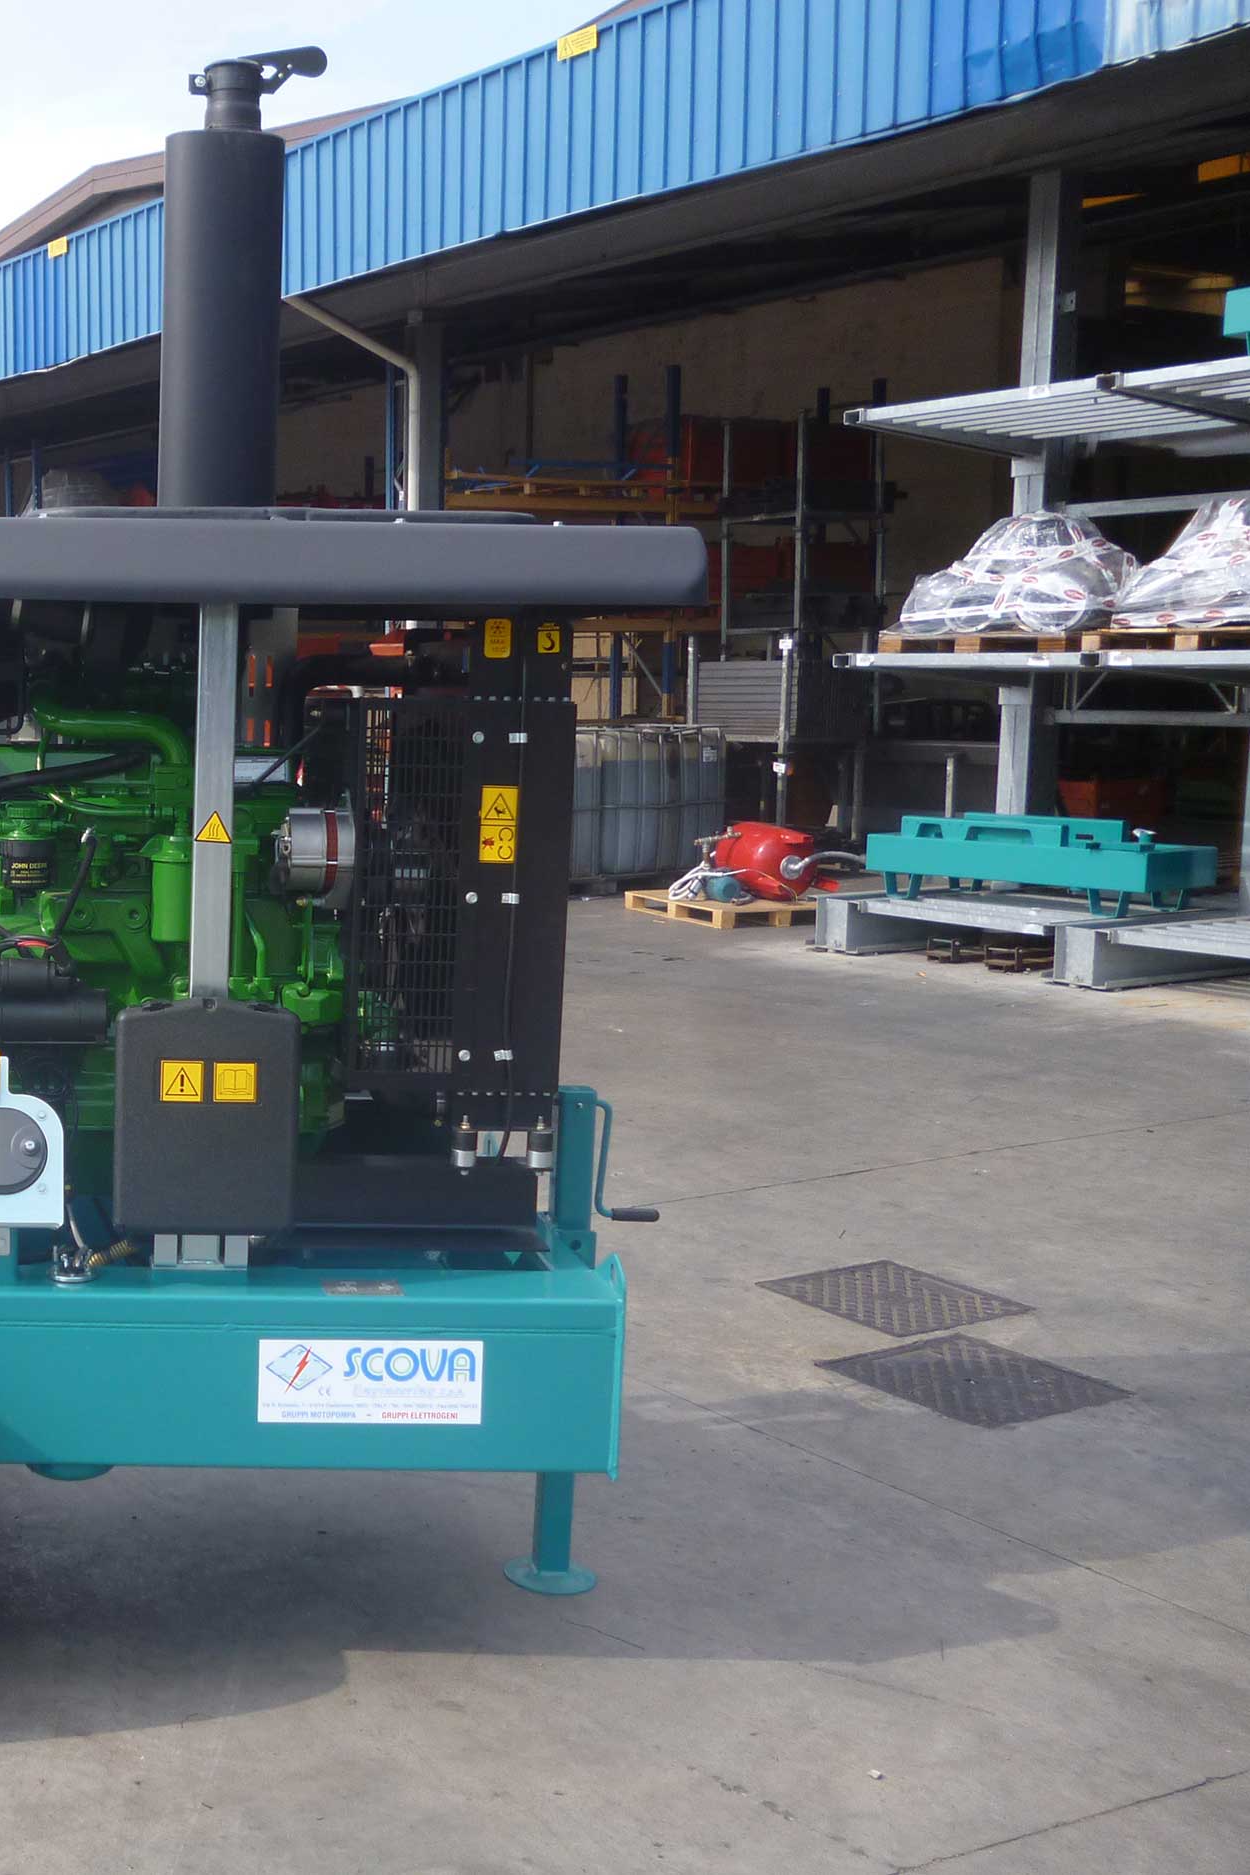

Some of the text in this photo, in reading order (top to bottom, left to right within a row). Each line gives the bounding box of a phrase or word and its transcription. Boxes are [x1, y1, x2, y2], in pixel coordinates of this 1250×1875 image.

[343, 1347, 476, 1382] SCOVA
[281, 1411, 309, 1419] GRUPPI
[310, 1411, 356, 1419] MOTOPOMPA
[381, 1411, 409, 1420] GRUPPI
[410, 1411, 458, 1420] ELETTROGENI
